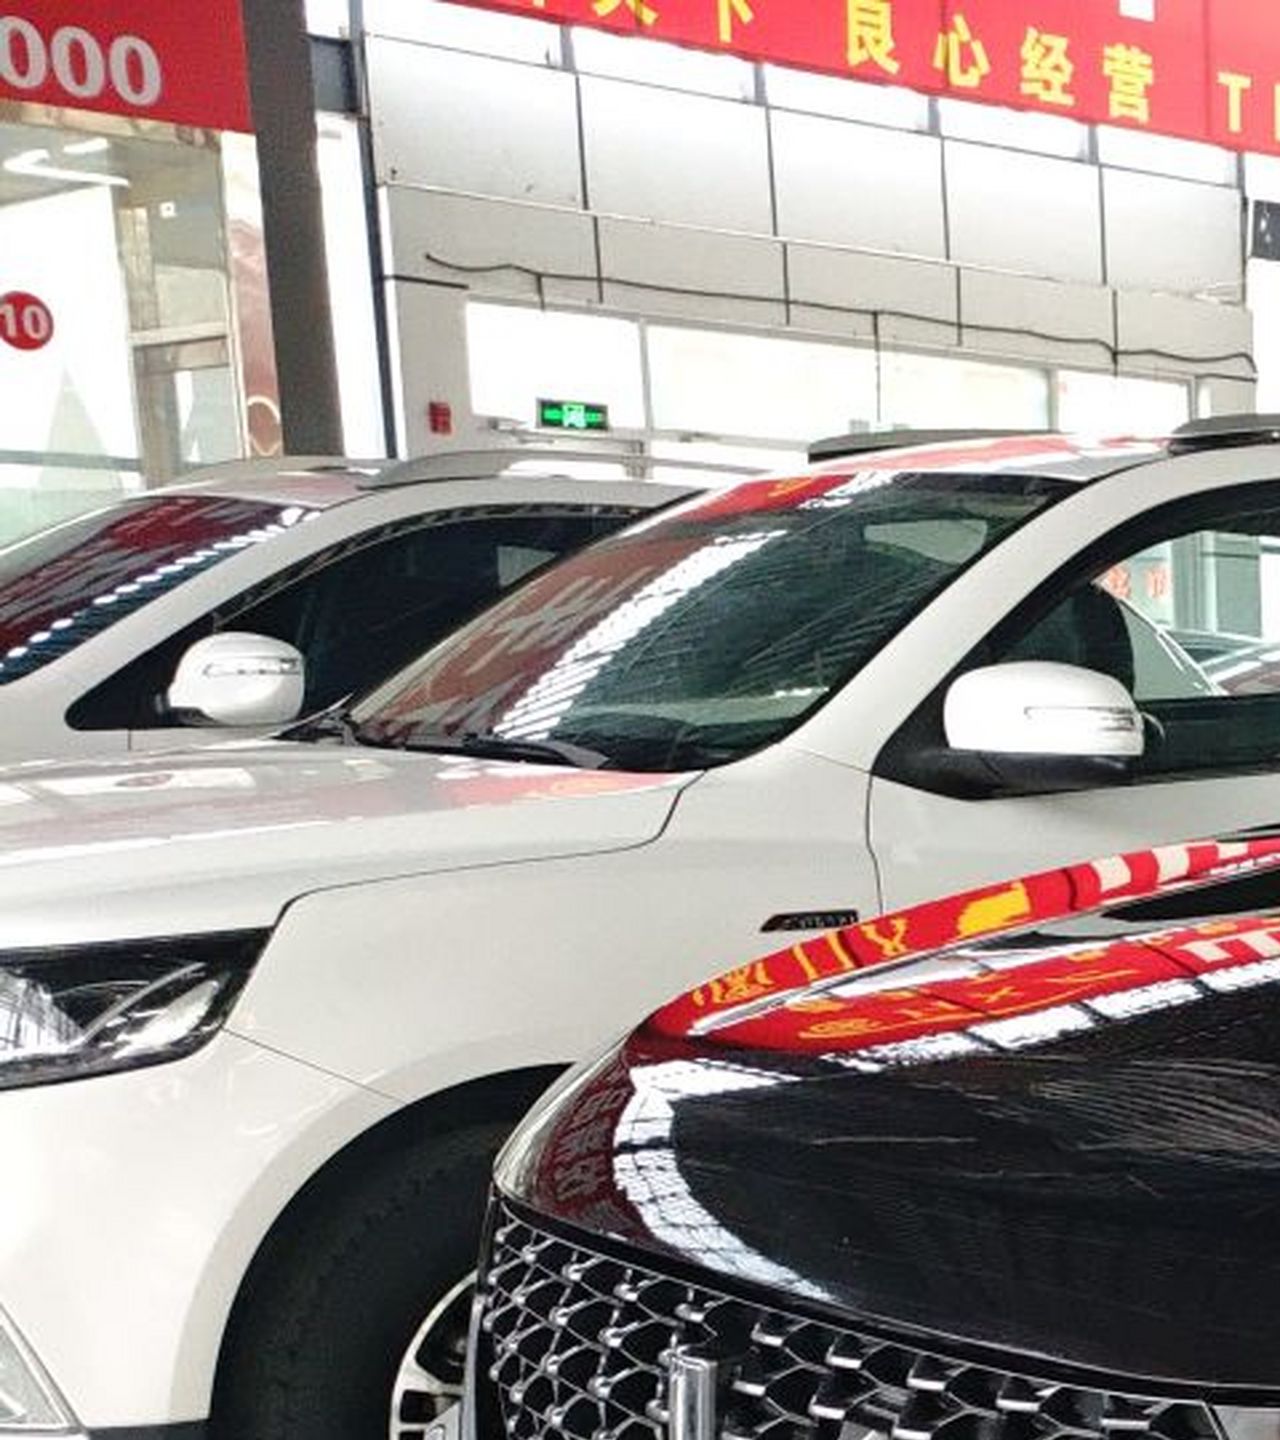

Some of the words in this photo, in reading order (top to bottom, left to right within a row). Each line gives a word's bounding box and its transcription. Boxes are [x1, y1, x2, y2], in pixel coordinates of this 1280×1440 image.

[845, 0, 1154, 122] 良心经营
[0, 303, 49, 339] 10
